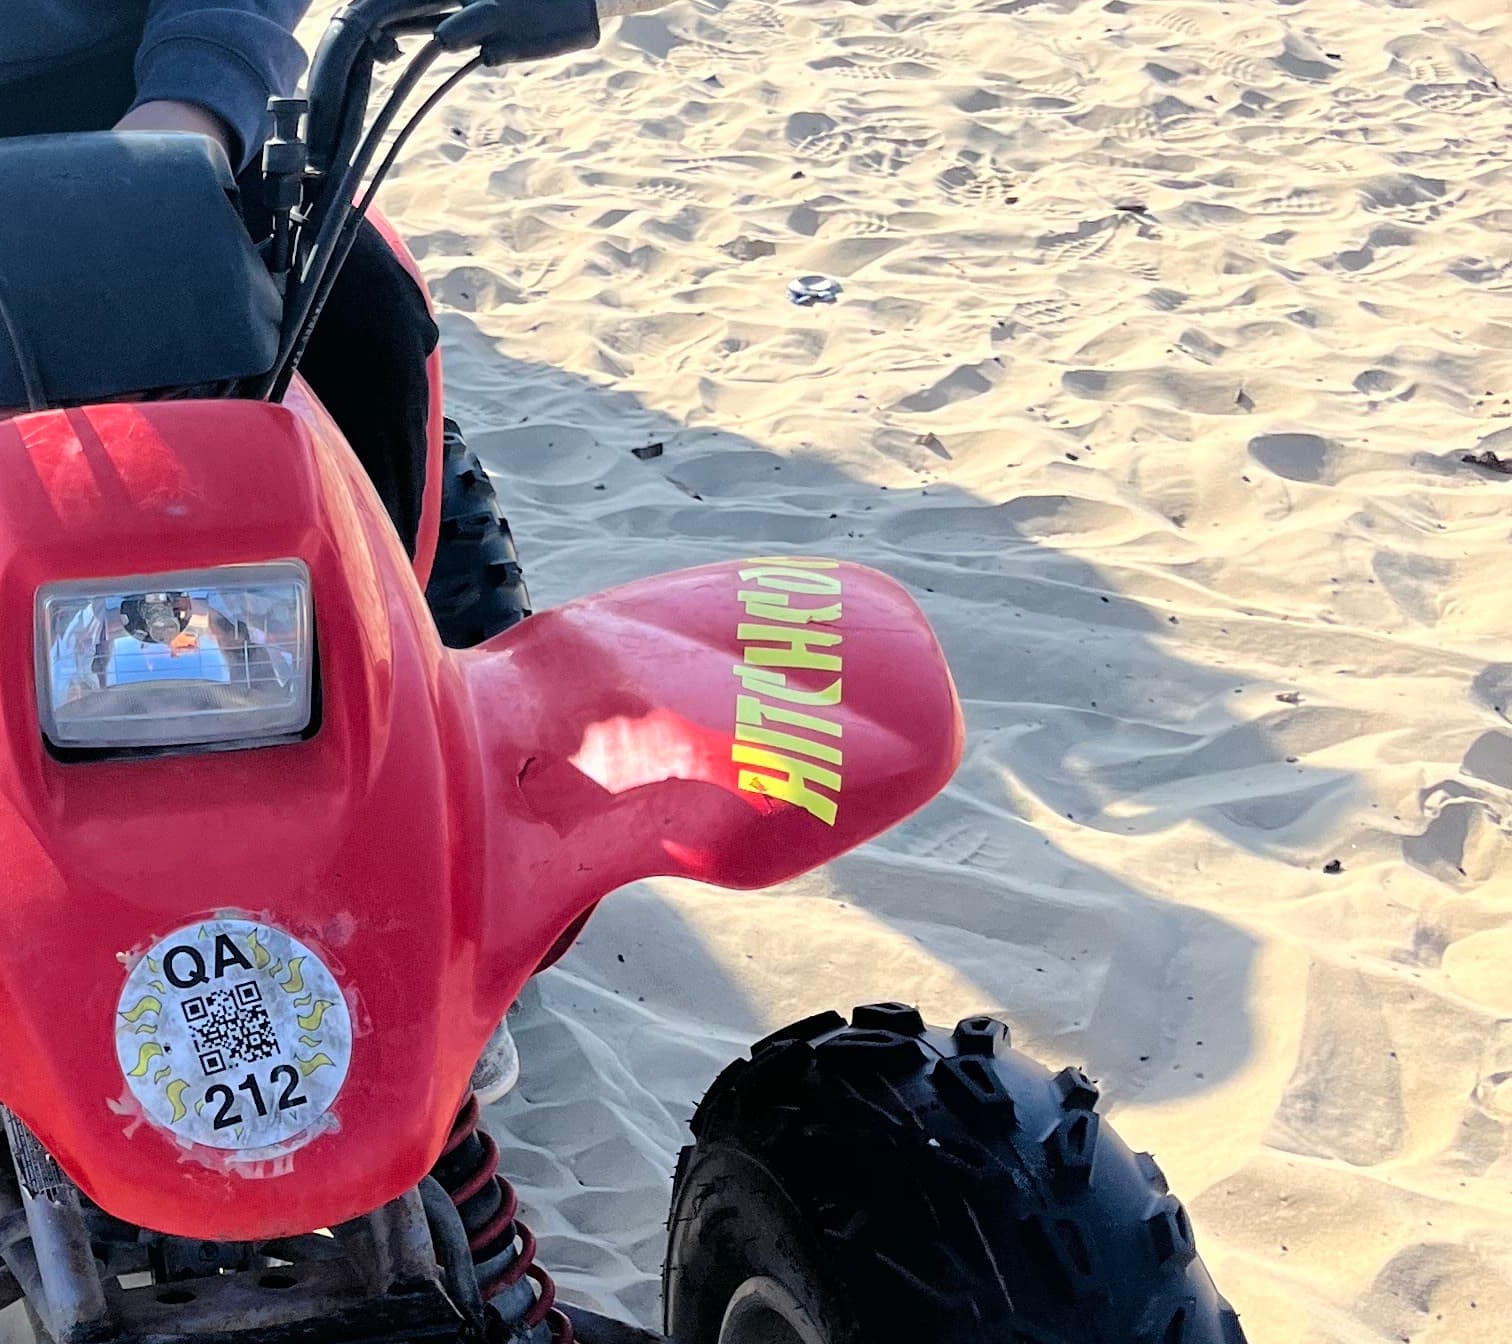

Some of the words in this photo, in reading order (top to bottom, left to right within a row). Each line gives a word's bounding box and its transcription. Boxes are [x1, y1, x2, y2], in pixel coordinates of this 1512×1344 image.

[732, 557, 844, 827] HITCHCO
[161, 933, 253, 990] QA
[204, 1063, 308, 1131] 212
